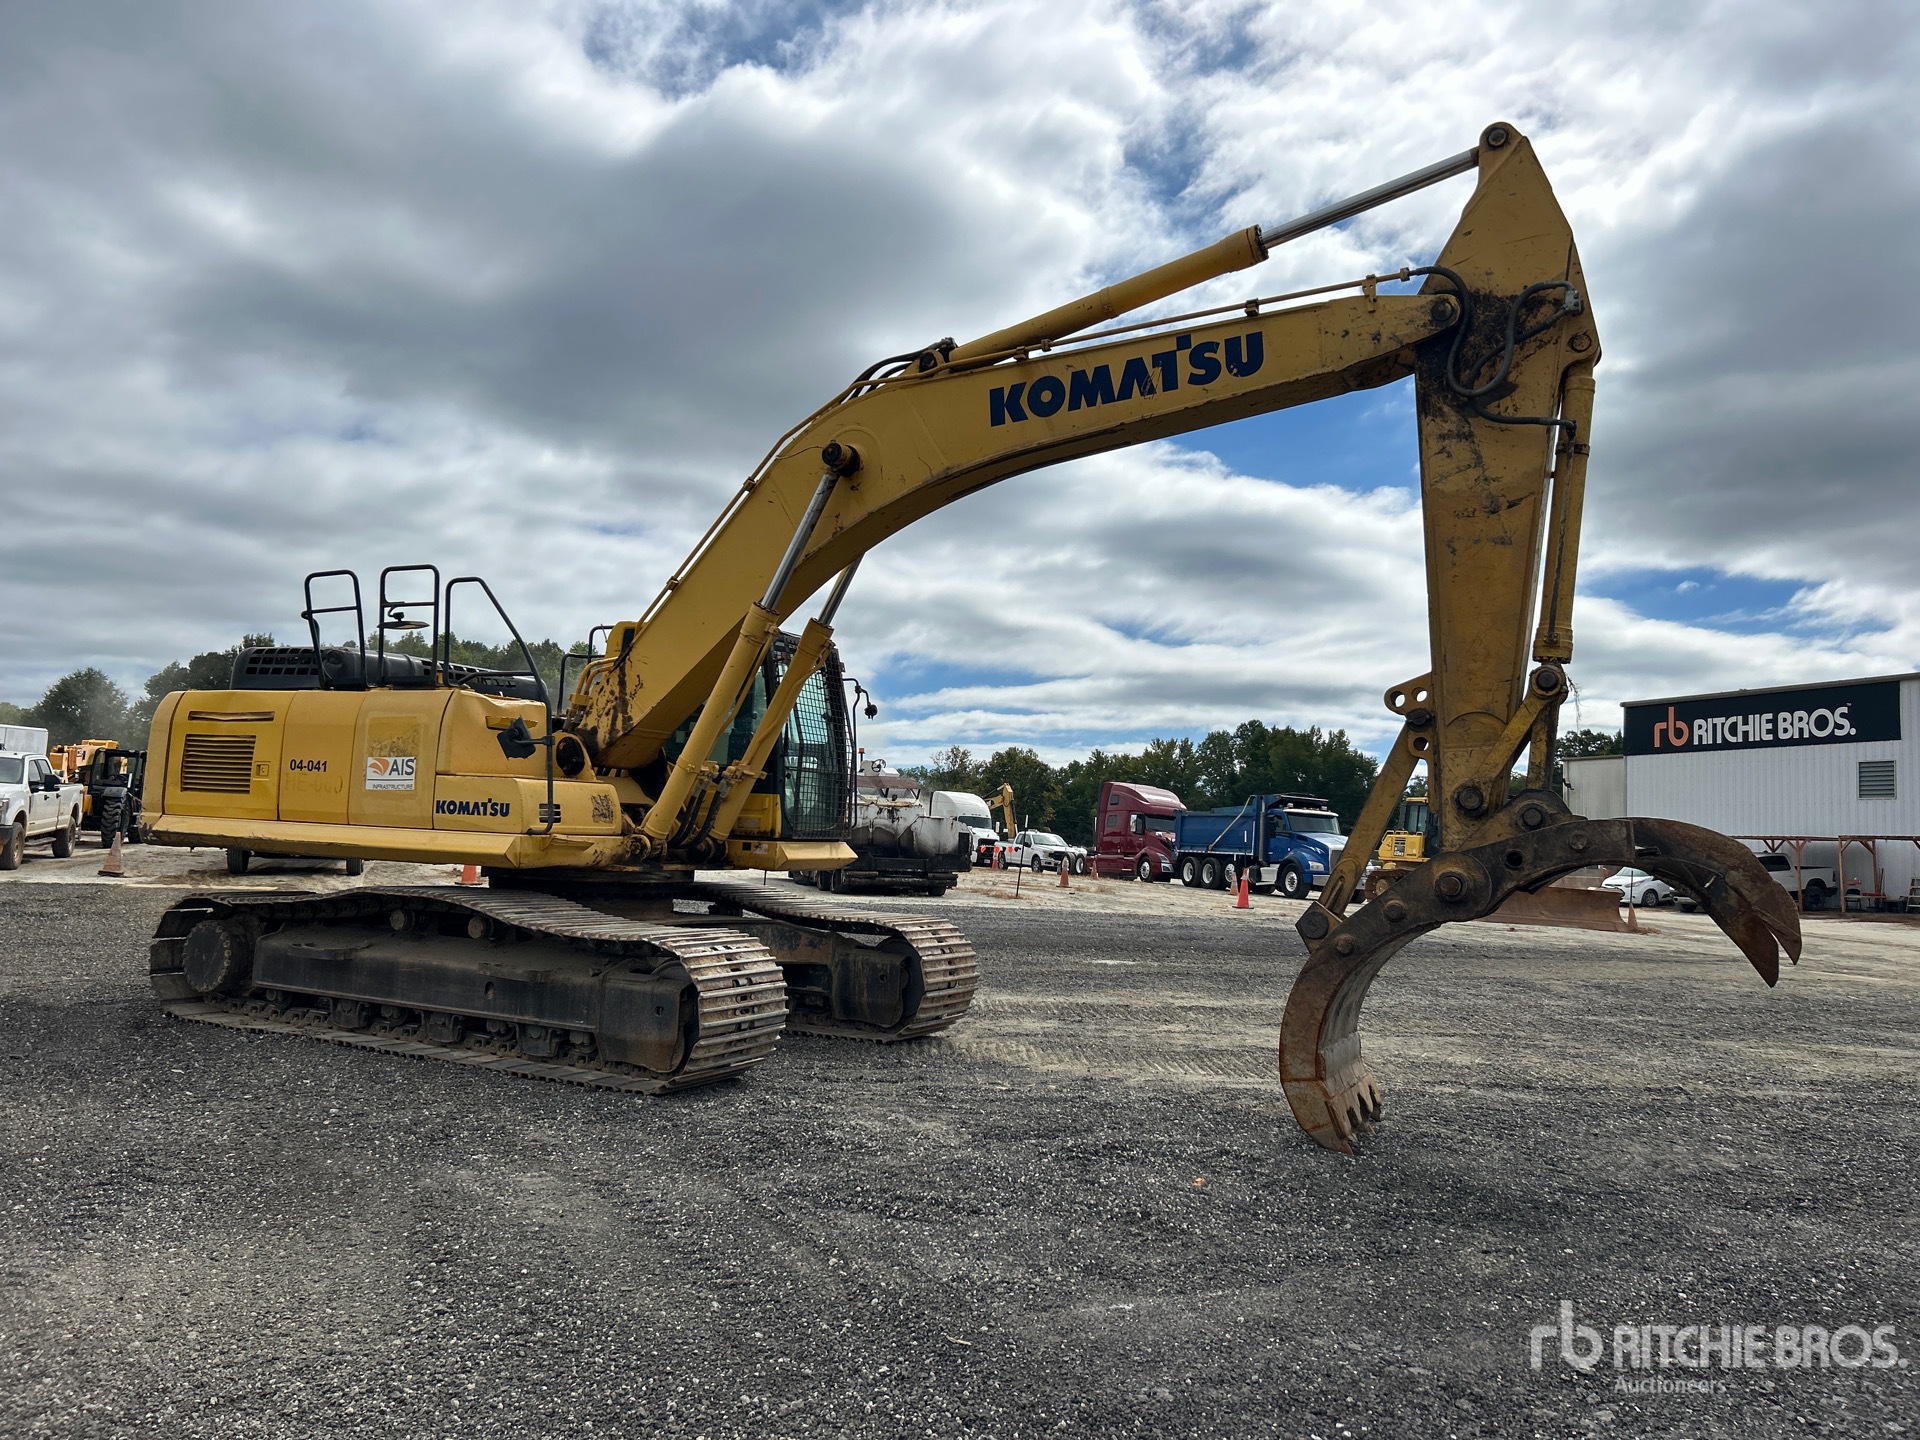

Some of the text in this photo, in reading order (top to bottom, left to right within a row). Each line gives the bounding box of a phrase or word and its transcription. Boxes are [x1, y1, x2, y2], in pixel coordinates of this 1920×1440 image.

[989, 331, 1264, 427] KOMATSU
[1654, 706, 1857, 748] rb RITCHIE BROS.
[289, 759, 328, 772] 04-041
[389, 758, 415, 776] AIS
[435, 798, 511, 818] KOMATSU
